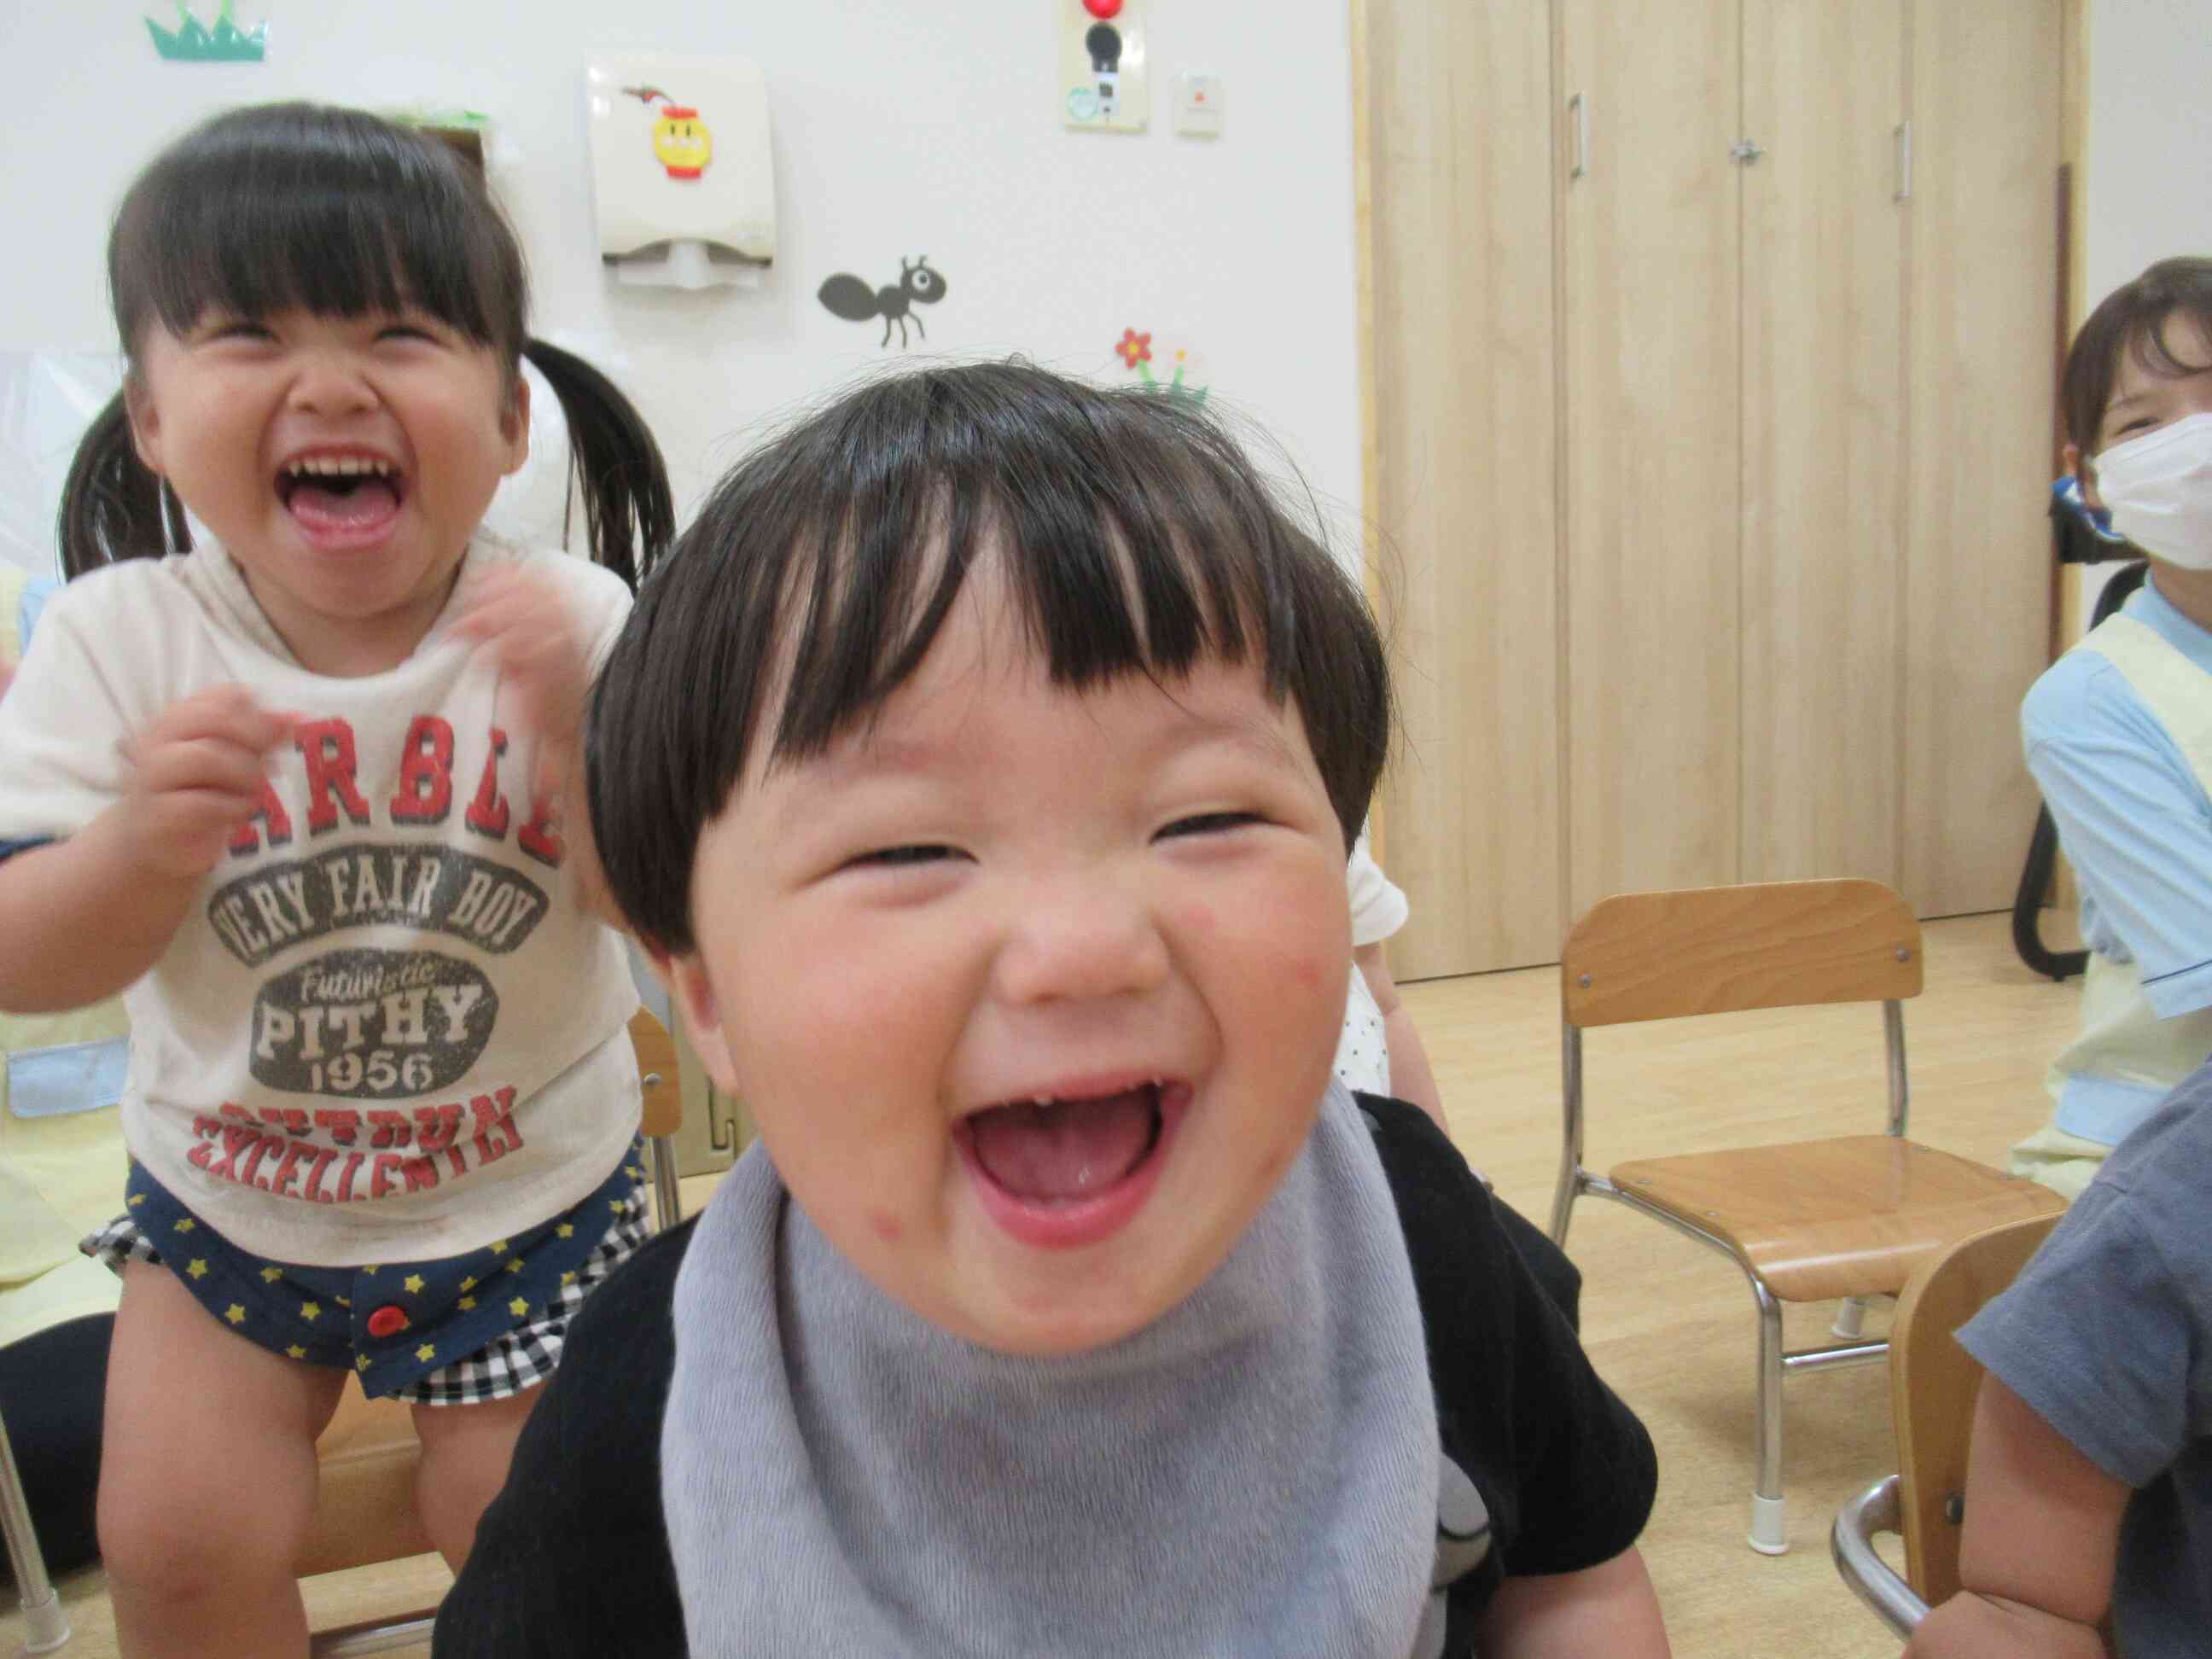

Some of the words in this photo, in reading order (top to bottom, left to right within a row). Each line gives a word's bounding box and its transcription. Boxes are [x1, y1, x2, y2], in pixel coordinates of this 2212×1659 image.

[214, 871, 315, 960] VERY
[327, 853, 442, 918] FAIR
[448, 869, 538, 946] BOY
[257, 983, 484, 1060] PITHY
[311, 1050, 434, 1091] 1956
